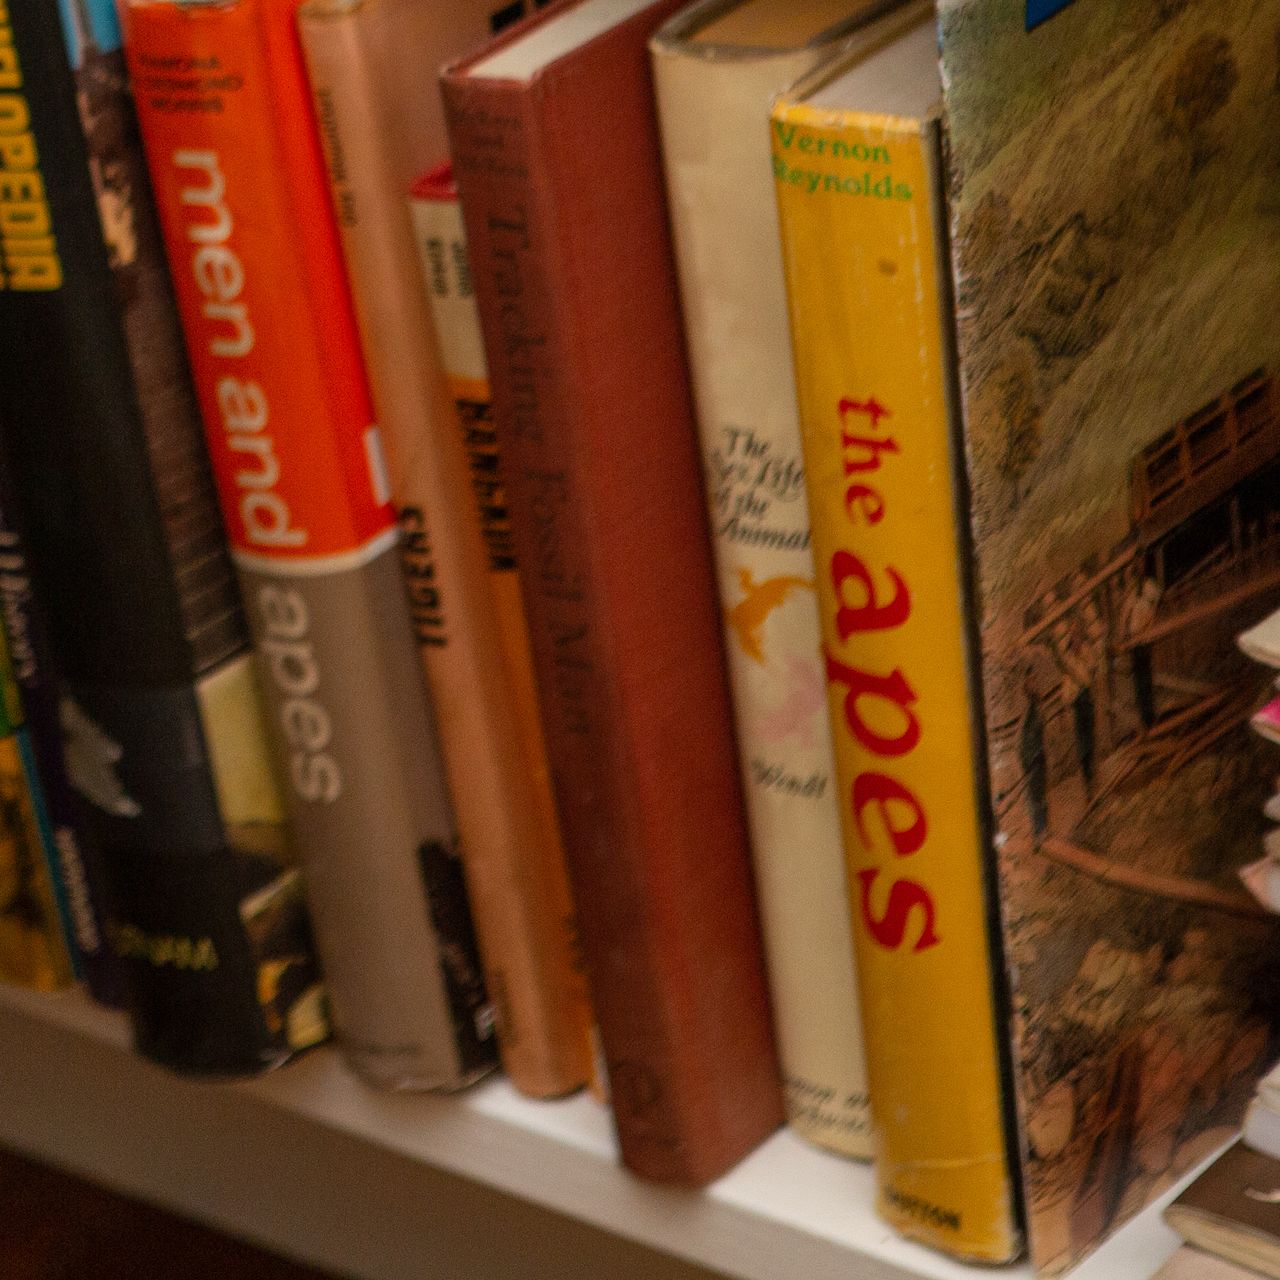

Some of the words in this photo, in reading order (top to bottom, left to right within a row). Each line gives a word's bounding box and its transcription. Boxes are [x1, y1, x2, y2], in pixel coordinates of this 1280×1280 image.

[774, 123, 893, 164] Vernon
[774, 157, 914, 203] Reynolds
[172, 147, 255, 359] men
[216, 375, 308, 548] and
[486, 206, 548, 442] Tracking
[525, 460, 580, 608] Fossil
[722, 422, 772, 458] The
[838, 396, 901, 527] the
[400, 505, 447, 649] TIGERS
[257, 586, 341, 805] apes
[826, 549, 943, 955] apes
